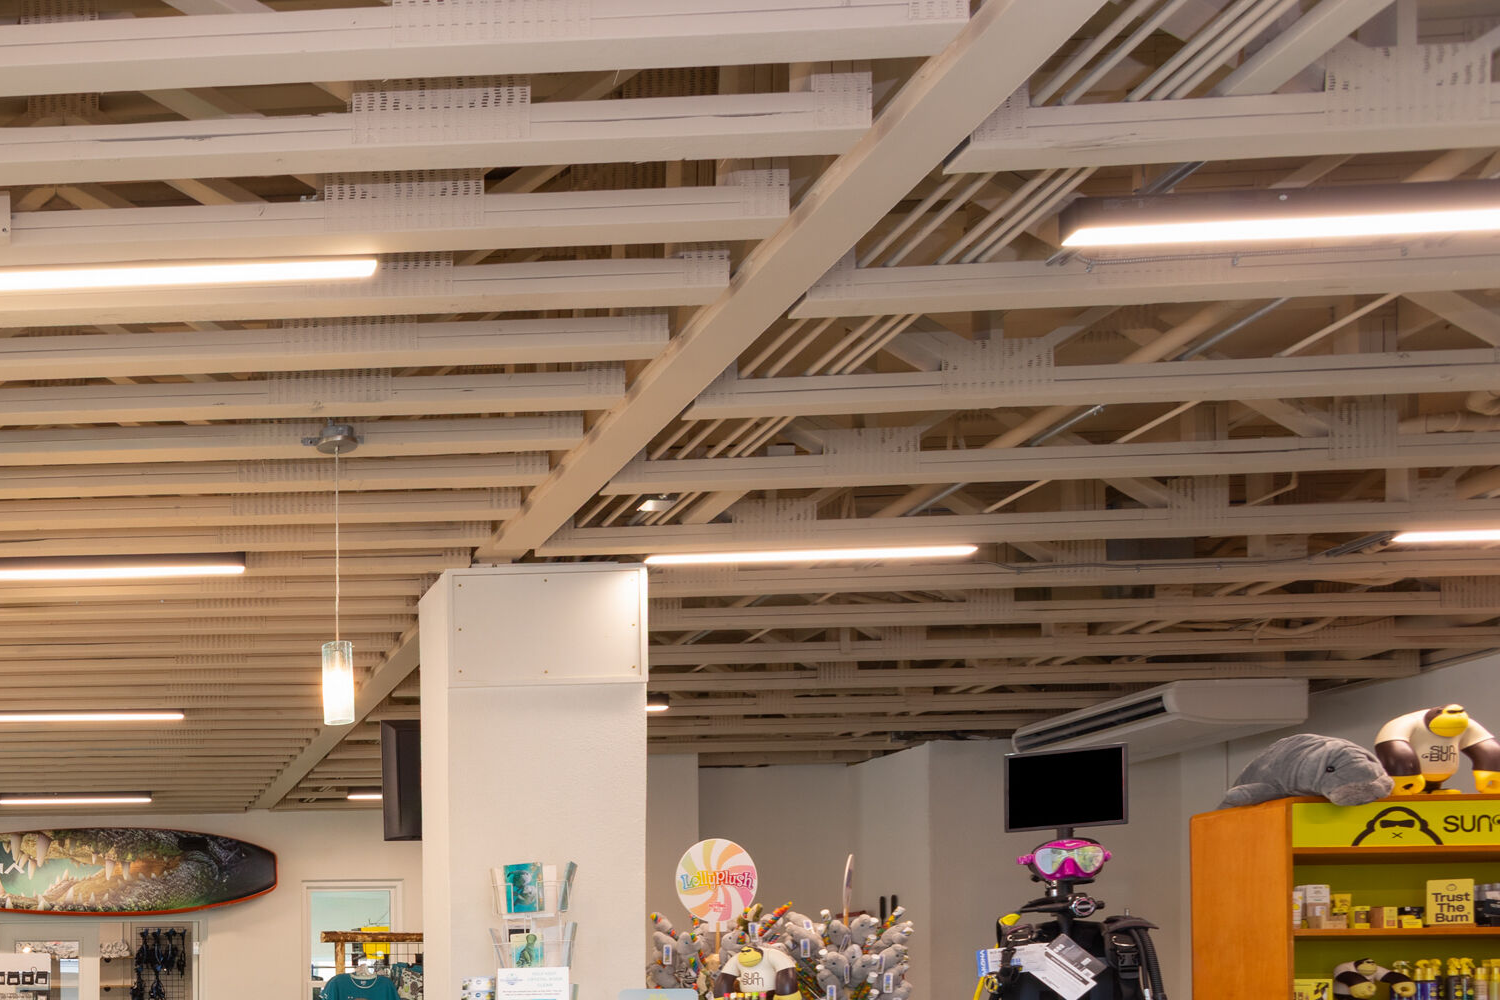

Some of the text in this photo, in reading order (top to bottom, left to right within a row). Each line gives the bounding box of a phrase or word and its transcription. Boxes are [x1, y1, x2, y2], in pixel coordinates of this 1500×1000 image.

[1432, 892, 1470, 902] Trust
[1438, 902, 1465, 912] The
[1435, 913, 1468, 922] Bum
